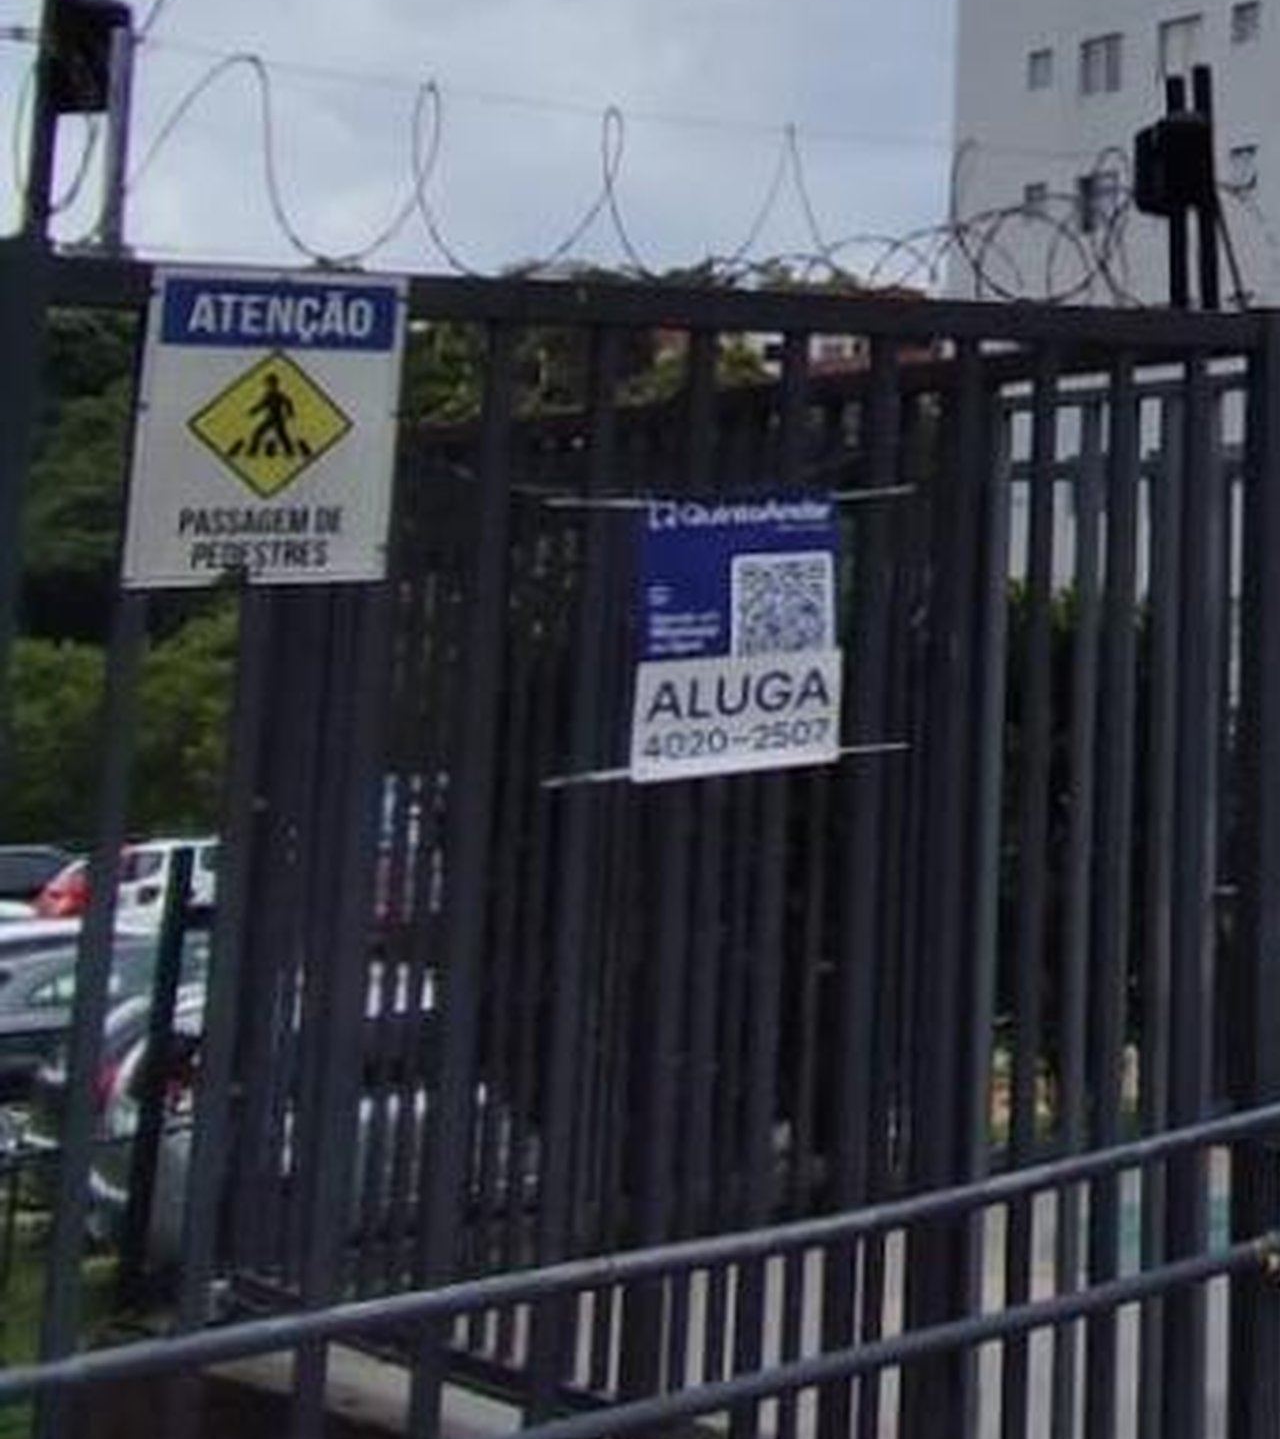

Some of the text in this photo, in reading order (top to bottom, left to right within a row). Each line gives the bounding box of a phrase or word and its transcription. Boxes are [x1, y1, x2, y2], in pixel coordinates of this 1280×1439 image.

[188, 292, 375, 342] ATENÇÃO
[649, 669, 830, 721] ALUGA
[644, 718, 832, 760] 4020-2507
